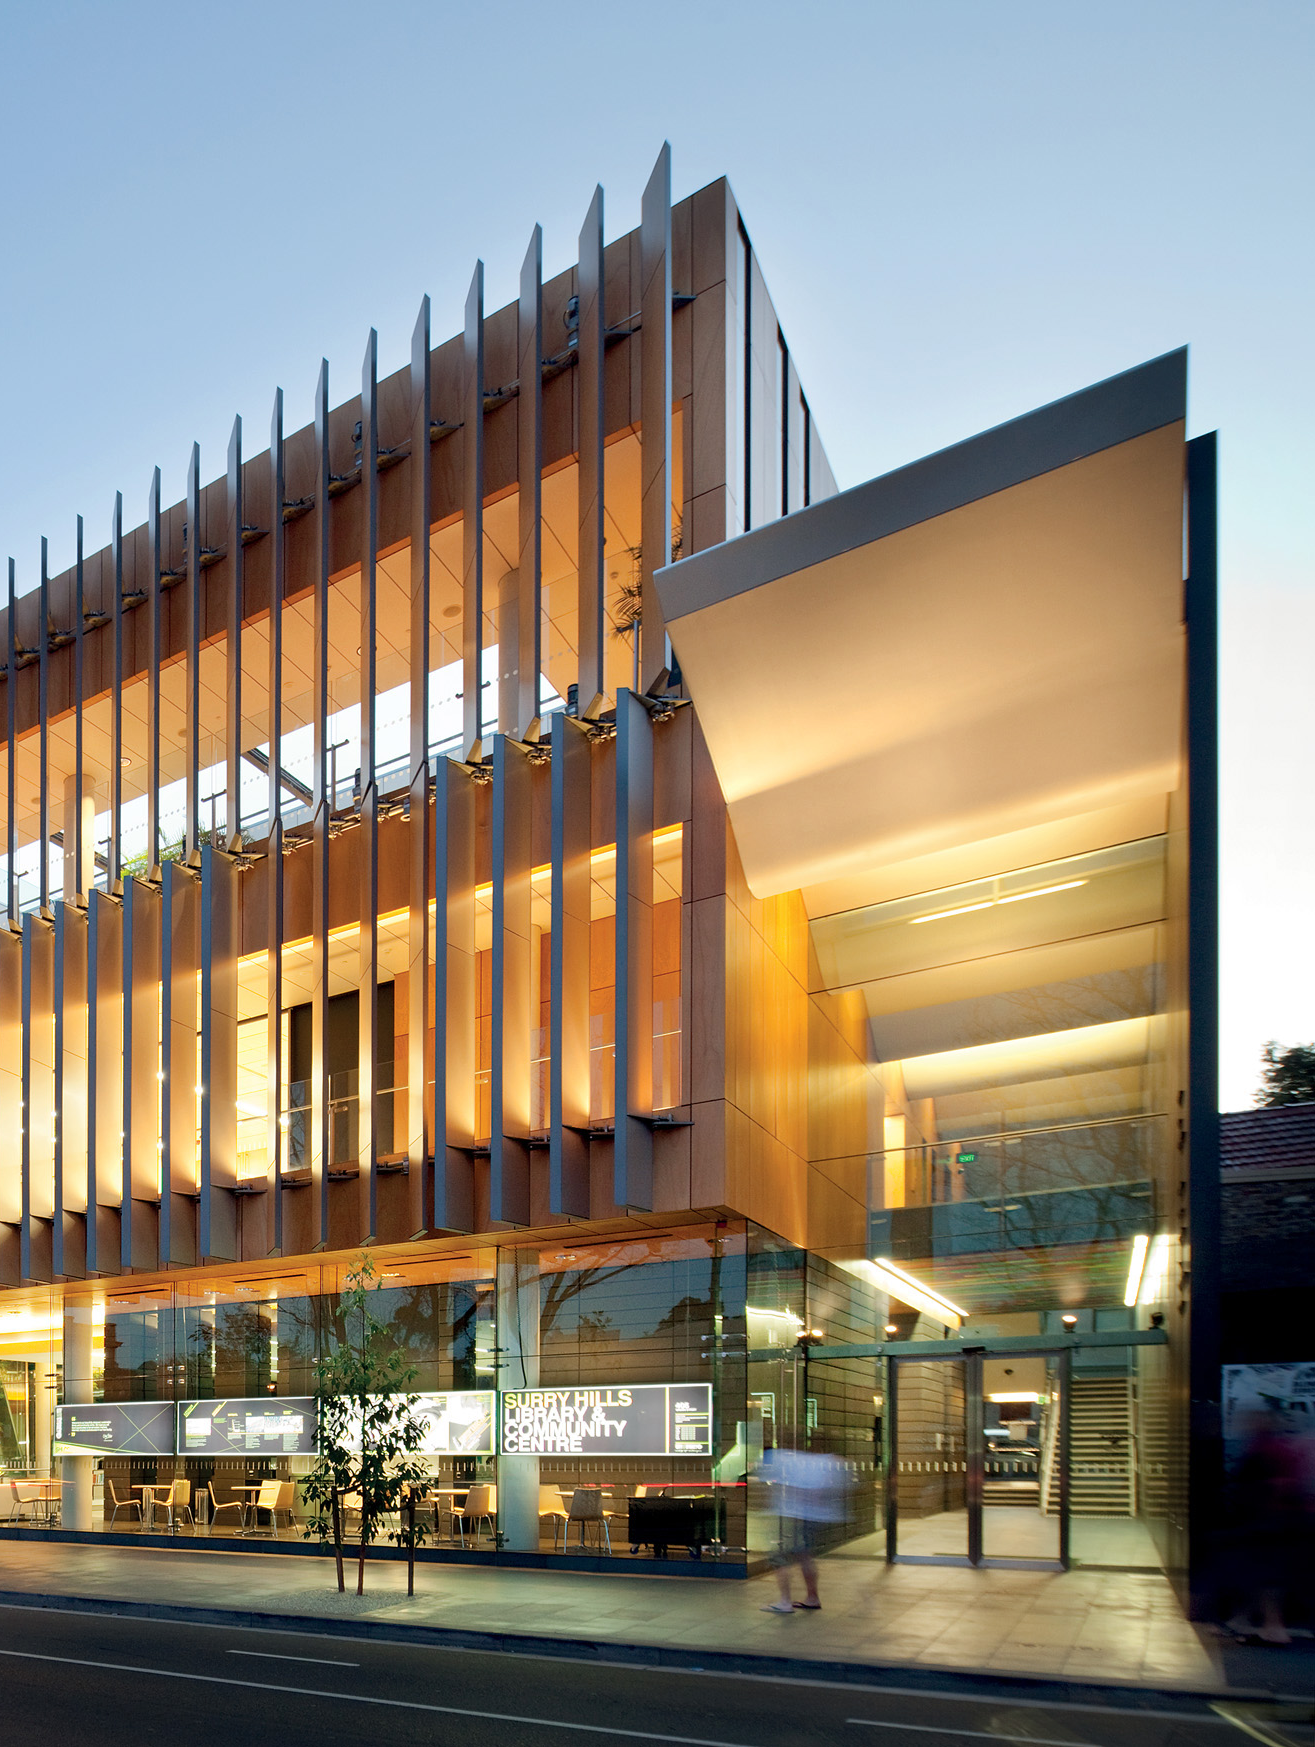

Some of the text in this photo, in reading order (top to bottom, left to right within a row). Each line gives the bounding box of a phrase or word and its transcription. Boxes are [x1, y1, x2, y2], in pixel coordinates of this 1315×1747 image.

[504, 1391, 571, 1409] SURRY
[574, 1389, 633, 1407] HILLS
[505, 1405, 606, 1423] LIBRARY &
[504, 1419, 627, 1437] COMMUNITY
[504, 1436, 583, 1452] CENTRE
